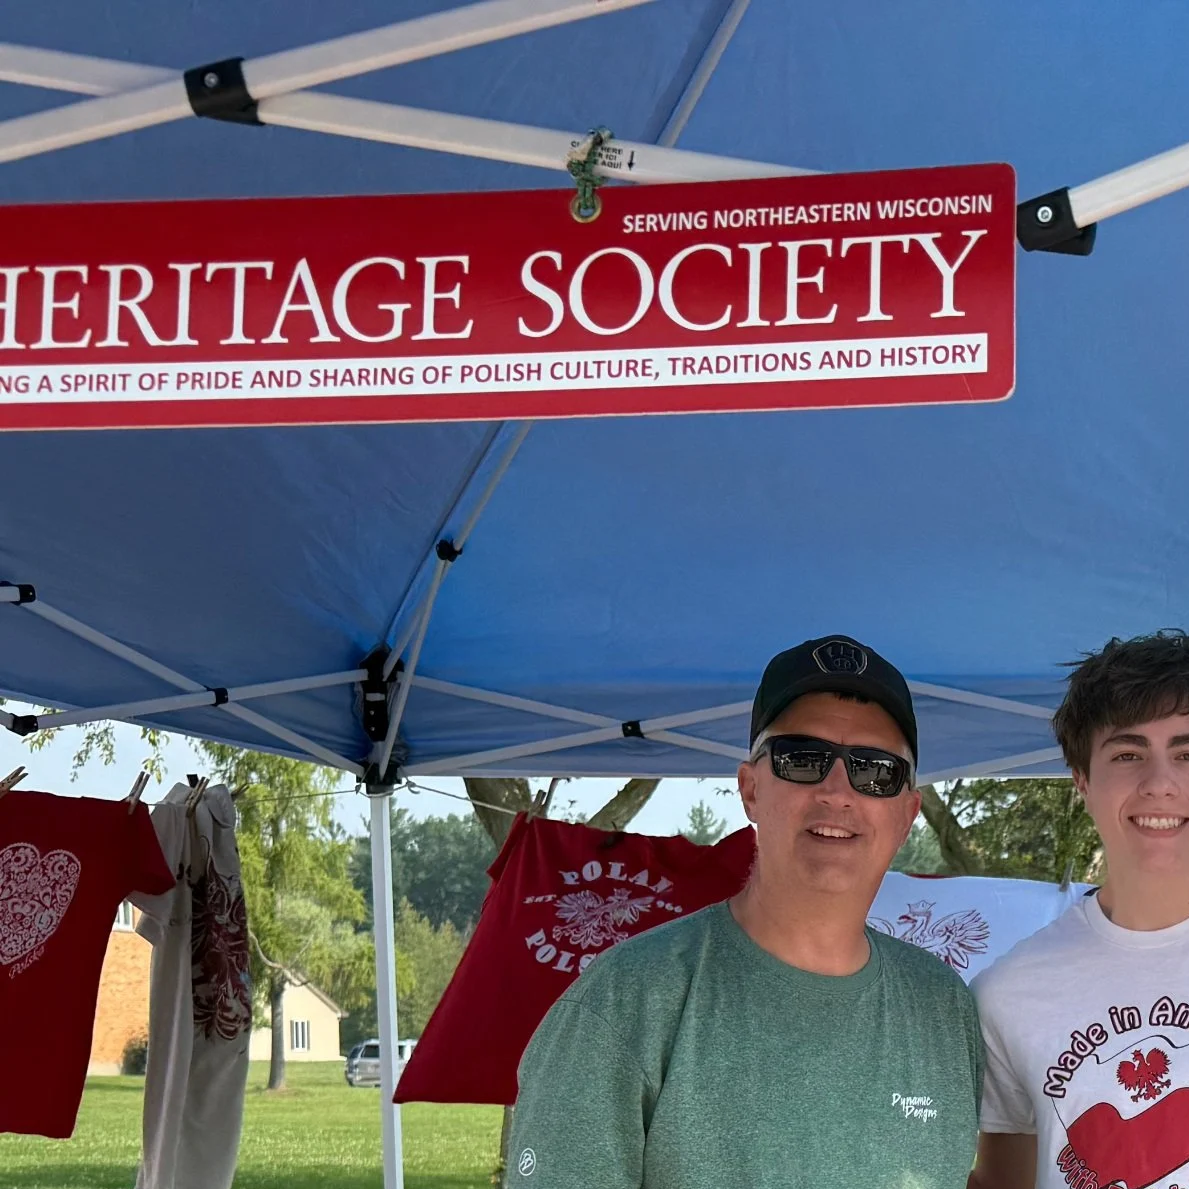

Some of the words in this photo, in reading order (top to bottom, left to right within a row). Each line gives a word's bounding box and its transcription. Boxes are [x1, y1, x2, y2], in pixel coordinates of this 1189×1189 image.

[623, 212, 708, 234] SERVING
[713, 203, 871, 229] NORTHEASTERN
[877, 195, 993, 220] WISCONSIN
[518, 230, 988, 339] SOCIETY
[37, 376, 53, 394] A
[60, 374, 131, 393] SPIRIT
[138, 372, 169, 391] OF
[176, 371, 243, 390] PRIDE
[250, 369, 302, 389] AND
[309, 367, 415, 388] SHARING
[422, 365, 453, 386] OF
[463, 362, 542, 384] POLISH
[550, 358, 661, 381] CULTURE,
[668, 353, 812, 377] TRADITIONS
[819, 348, 871, 370] AND
[880, 343, 982, 367] HISTORY
[1043, 1023, 1108, 1098] Made
[1109, 1006, 1142, 1034] in
[891, 1093, 933, 1111] Dynamic
[905, 1105, 938, 1123] Designs
